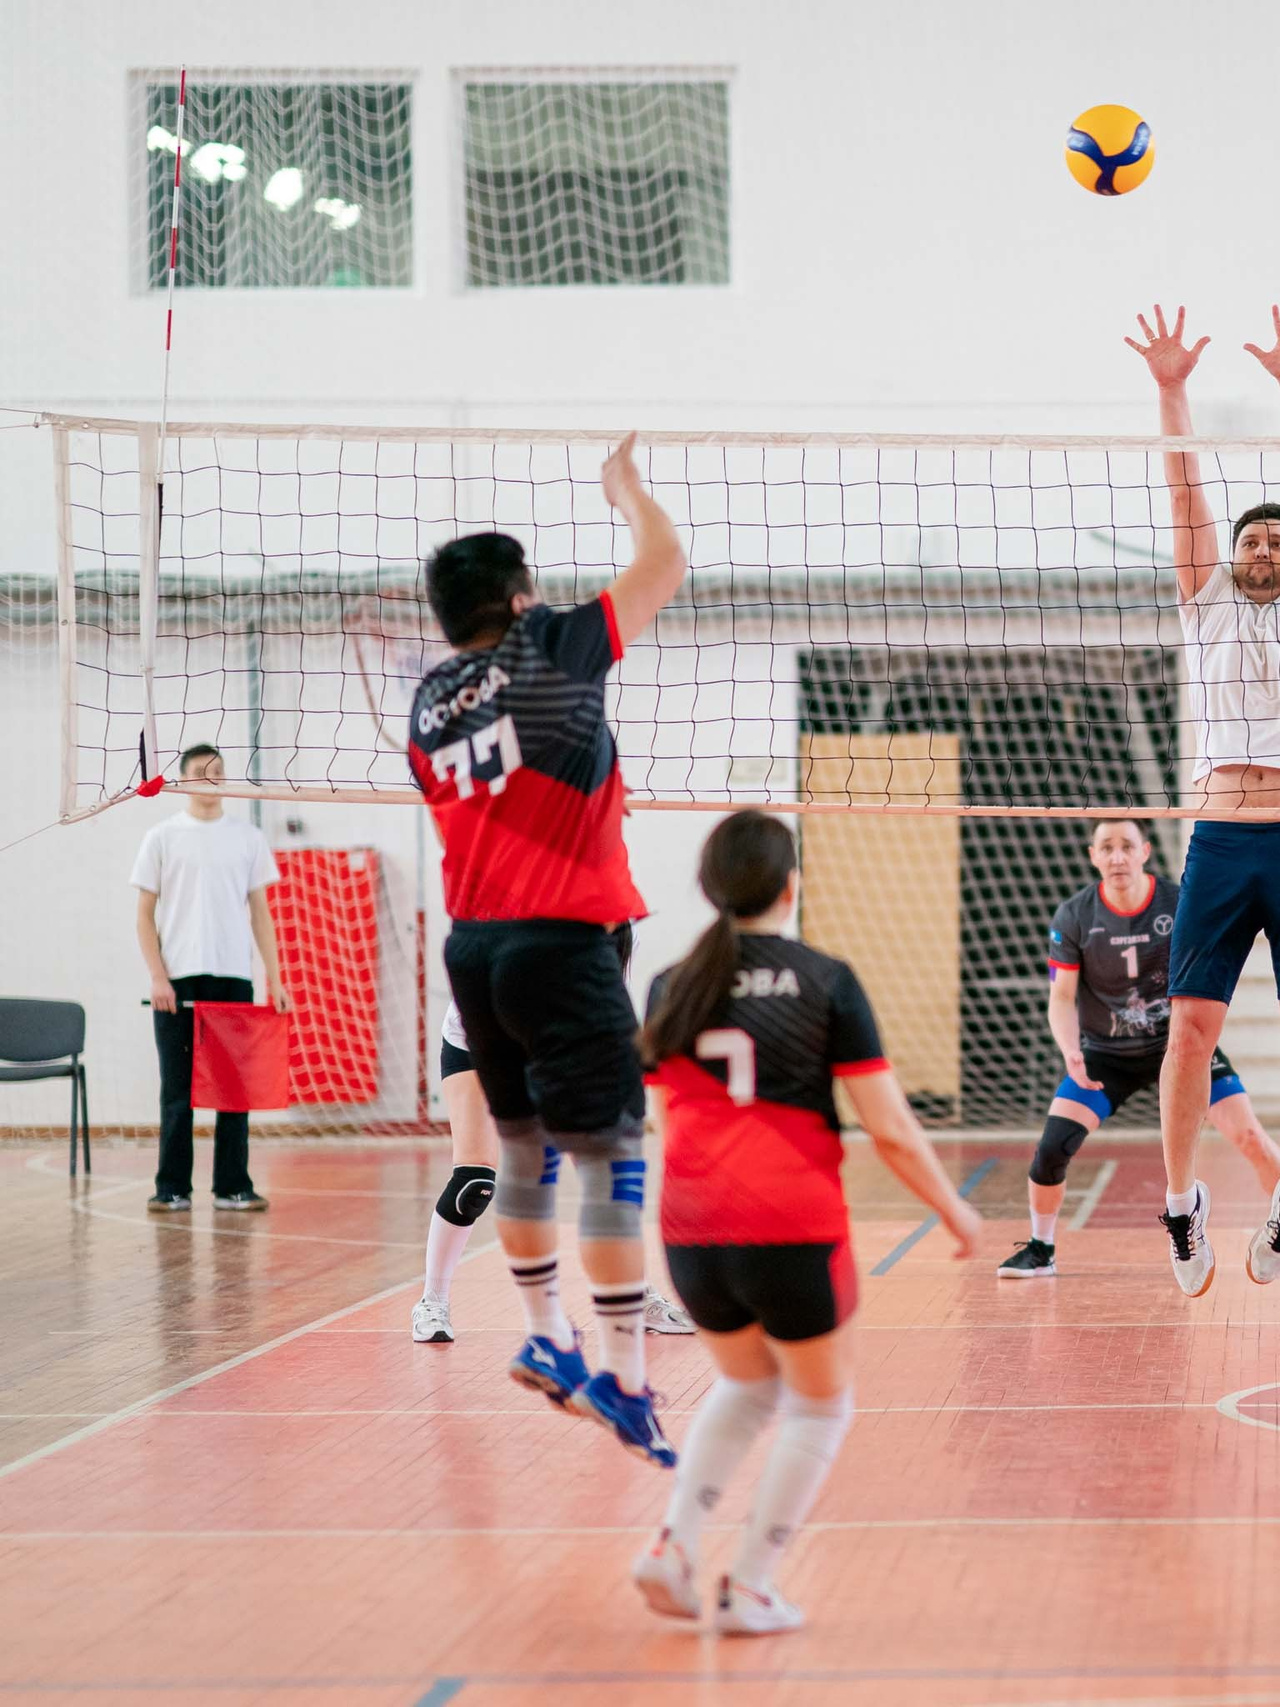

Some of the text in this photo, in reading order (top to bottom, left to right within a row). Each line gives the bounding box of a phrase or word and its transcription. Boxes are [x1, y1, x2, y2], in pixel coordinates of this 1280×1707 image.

[431, 714, 523, 799] 77
[1121, 946, 1138, 978] 1
[696, 1028, 756, 1107] 7
